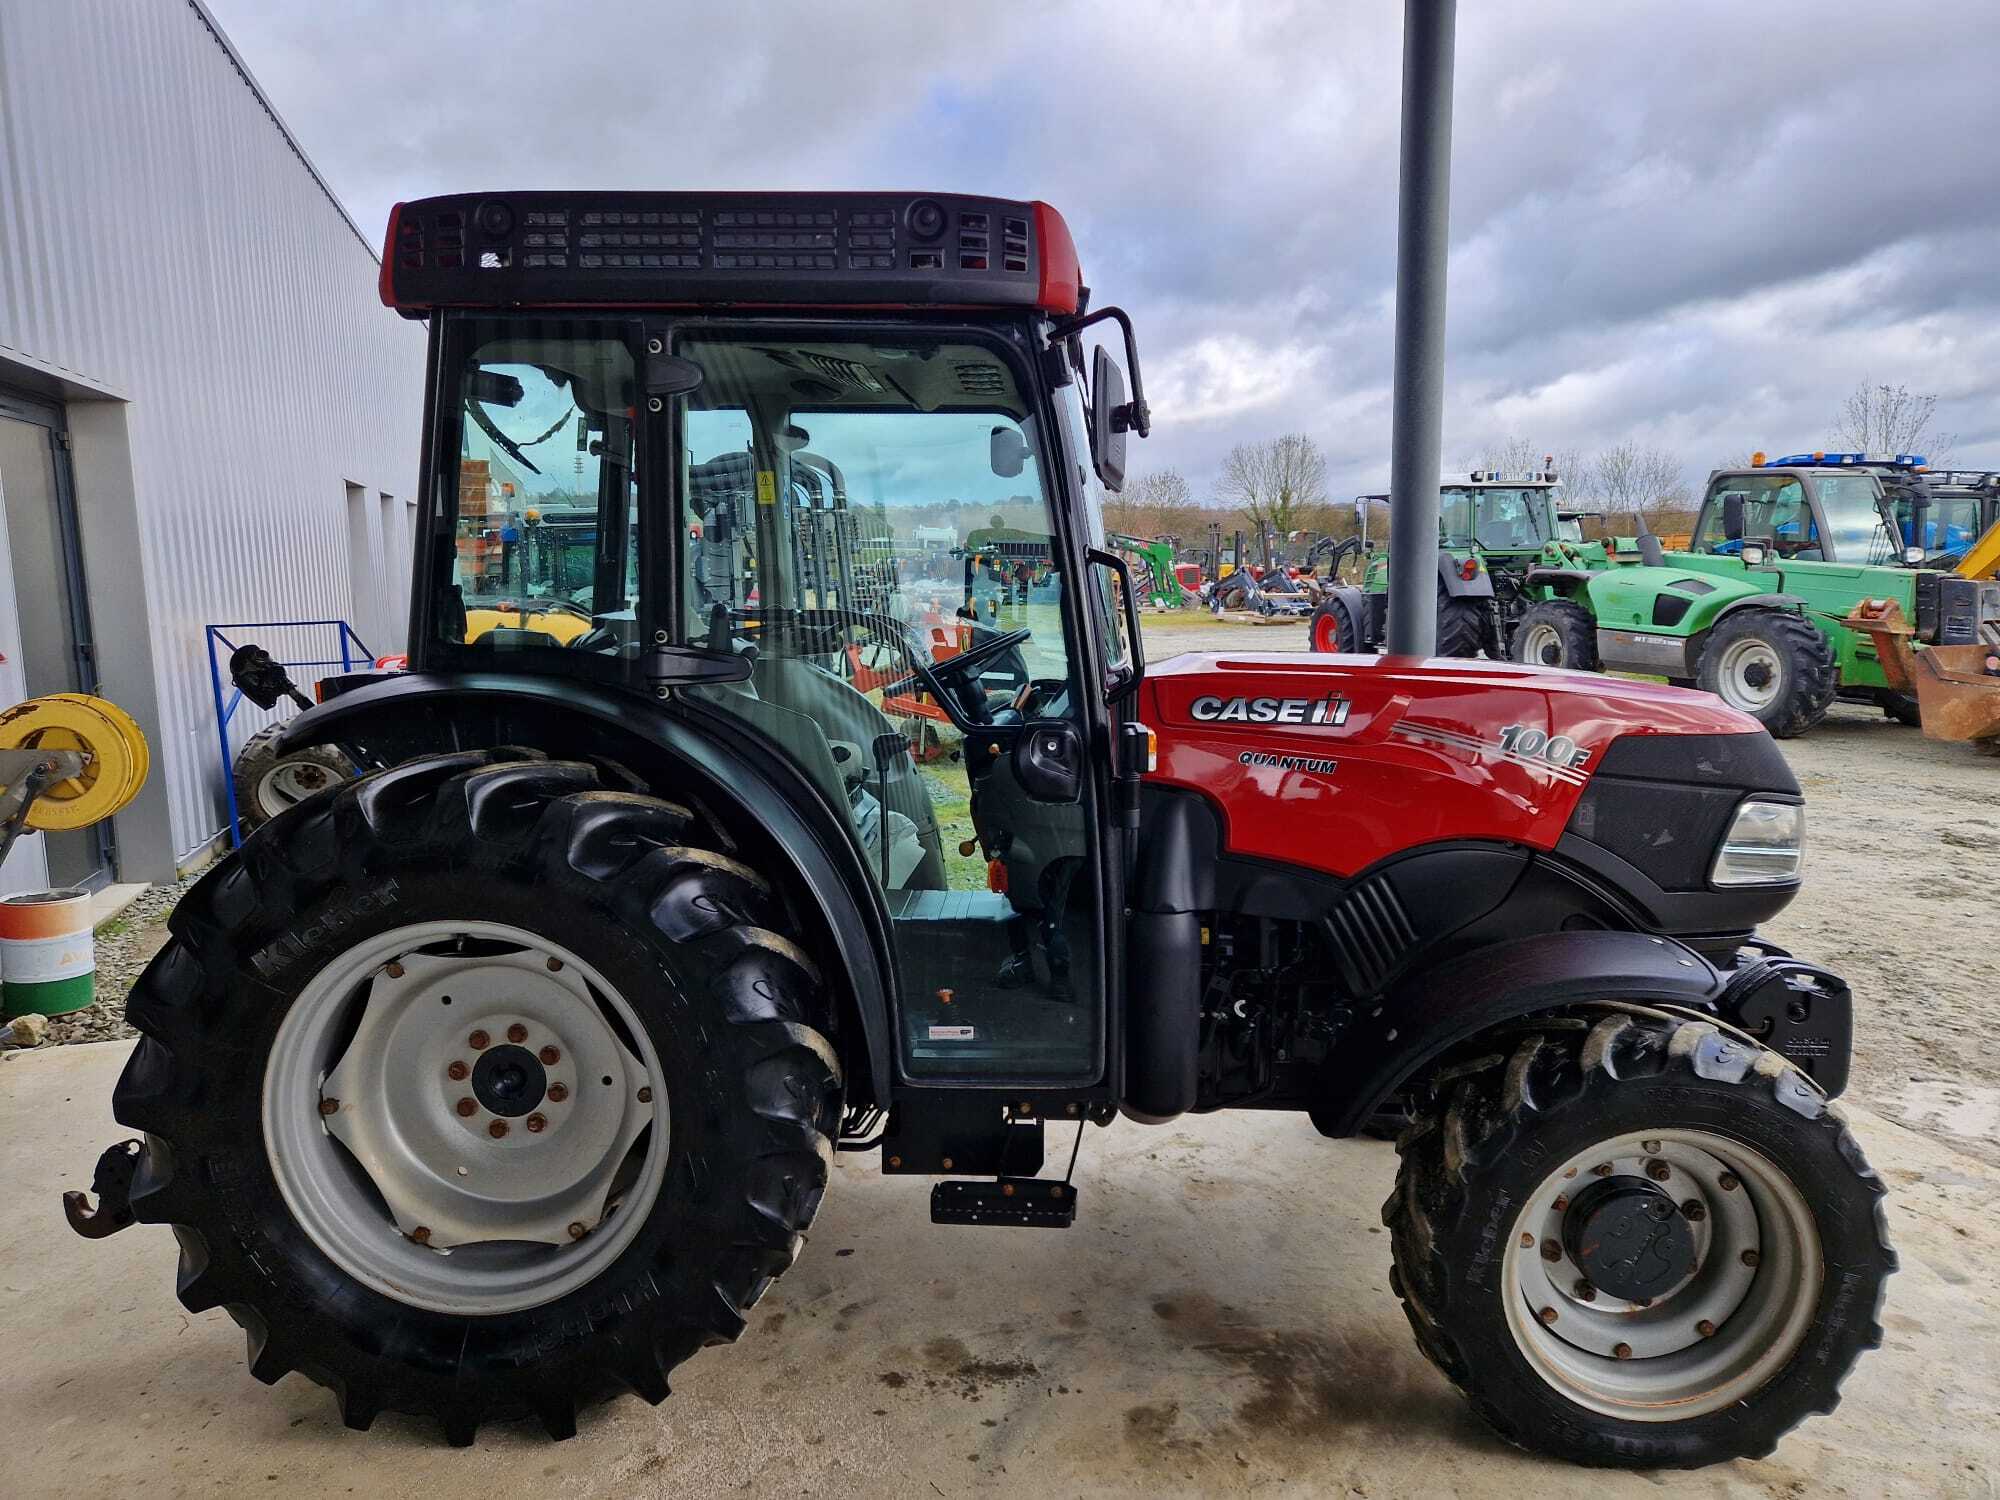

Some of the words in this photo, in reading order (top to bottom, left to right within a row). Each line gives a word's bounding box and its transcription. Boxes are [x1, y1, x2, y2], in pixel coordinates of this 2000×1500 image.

[1191, 697, 1308, 723] CASE
[1499, 724, 1592, 768] 100F
[1239, 752, 1337, 774] QUANTUM
